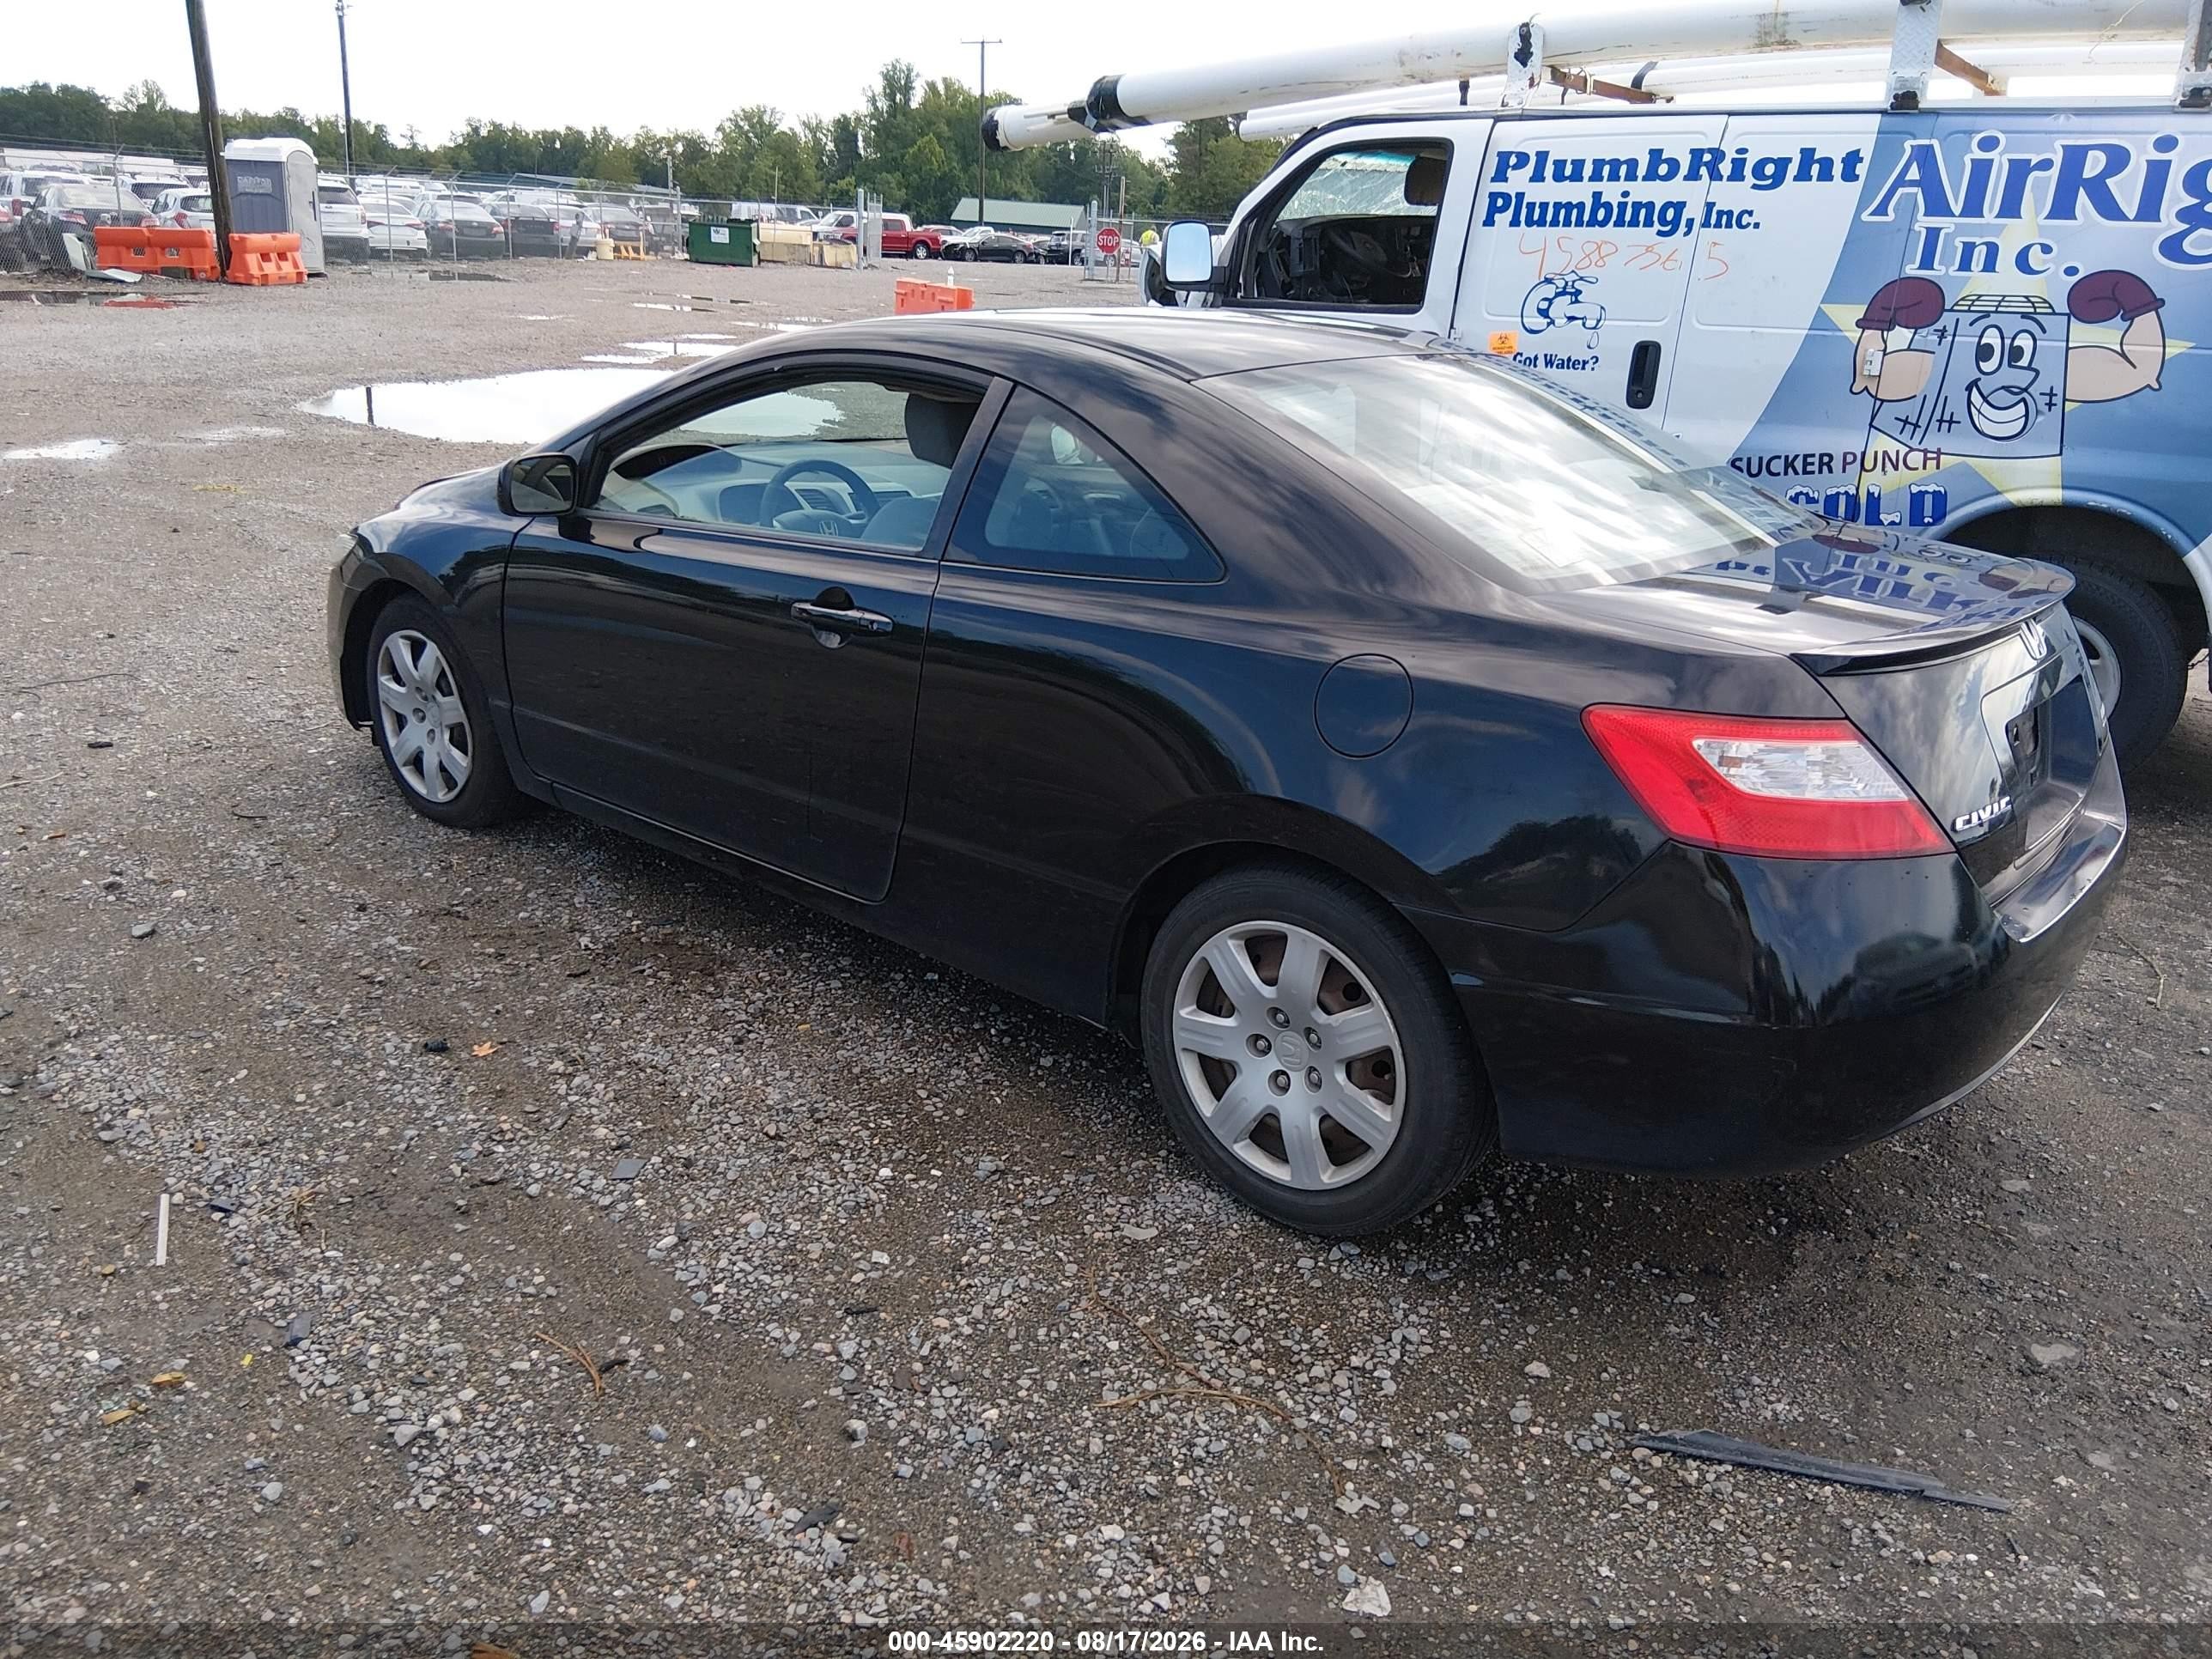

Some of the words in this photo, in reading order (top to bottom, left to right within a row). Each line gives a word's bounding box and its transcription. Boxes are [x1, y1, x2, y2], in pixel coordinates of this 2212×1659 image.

[1490, 147, 1863, 191] PlumbRight
[1482, 191, 1694, 237] Plumbing,
[1701, 201, 1761, 230] Inc.
[1097, 234, 1120, 248] STOP
[1905, 223, 2081, 277] Inc.
[1543, 353, 1600, 372] Water?
[1730, 453, 1834, 478] SUCKER
[1841, 447, 1942, 474] PUNCH
[1952, 795, 2012, 832] CIVIC
